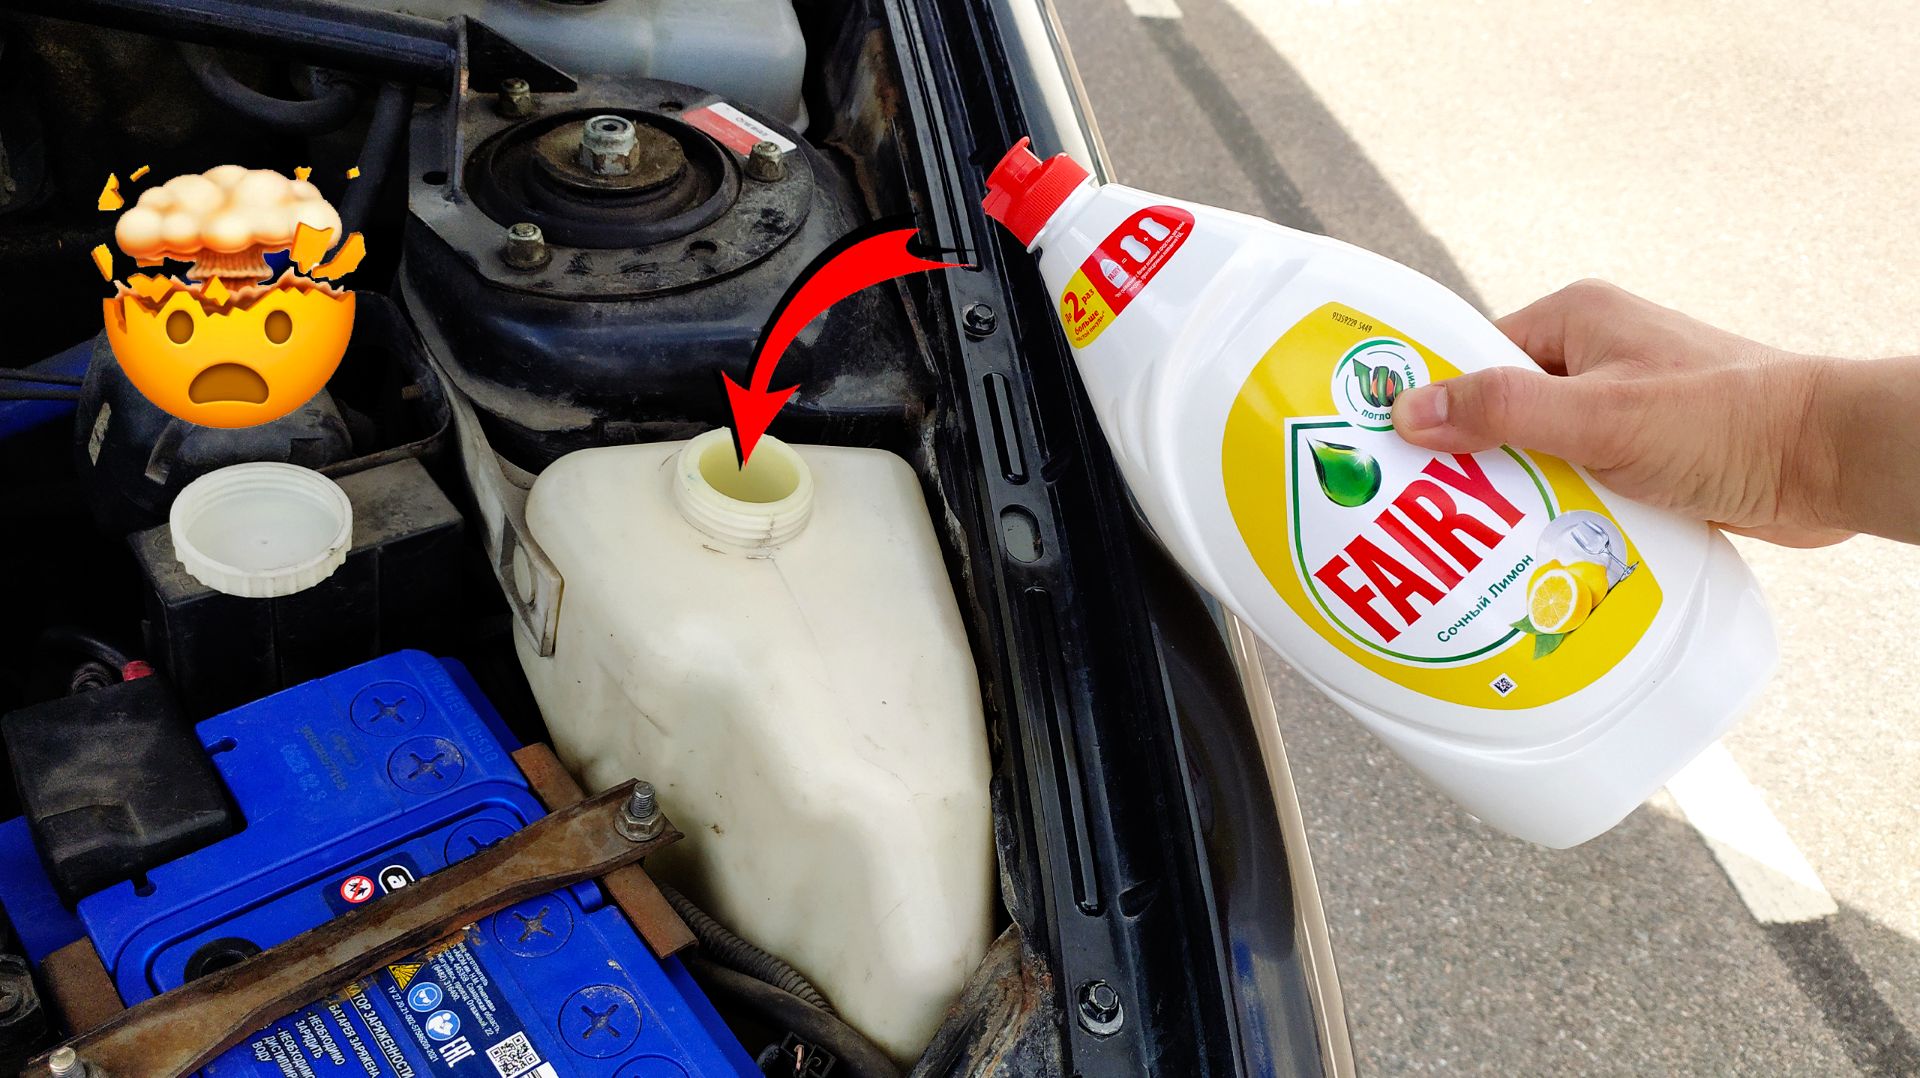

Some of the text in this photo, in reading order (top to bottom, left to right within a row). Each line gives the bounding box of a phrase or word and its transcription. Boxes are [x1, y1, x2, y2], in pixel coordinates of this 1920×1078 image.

[1063, 291, 1087, 323] 2
[1081, 288, 1095, 305] раз
[1074, 310, 1100, 336] больше
[1331, 311, 1373, 333] 91359229 5449
[1361, 409, 1391, 421] ПОГЛО
[1314, 453, 1526, 643] FAIRY
[1437, 554, 1534, 643] Сочный Лимон
[252, 1041, 272, 1061] ВОДУ
[295, 1020, 323, 1059] ЗАРЯДИТЬ
[307, 1013, 345, 1065] НЕОБХОДИМО
[328, 1002, 380, 1077] БАТАРЕЯ ЗАРЯЖЕНА
[363, 1009, 414, 1078] ЗАРЯЖЕННОСТИ
[484, 1027, 493, 1036] 22
[262, 1036, 298, 1078] ДИСТИЛЛИР
